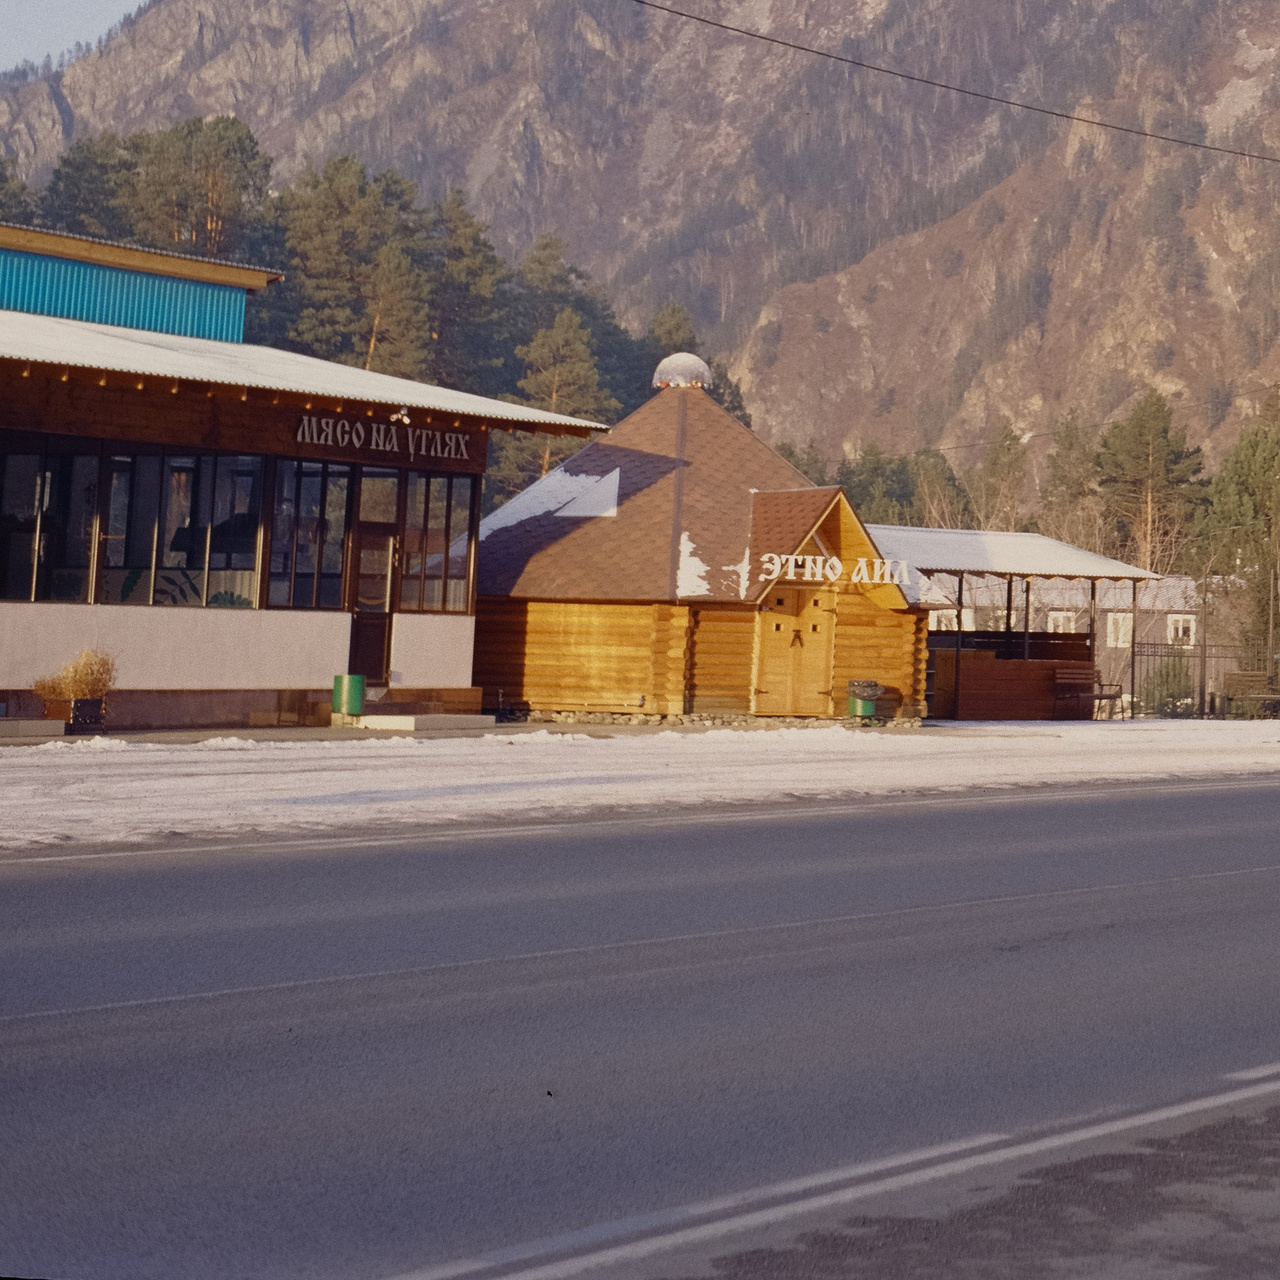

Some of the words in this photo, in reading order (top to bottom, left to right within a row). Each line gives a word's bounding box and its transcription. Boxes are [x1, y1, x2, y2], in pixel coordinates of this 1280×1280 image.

[296, 415, 365, 449] МЯСО
[369, 423, 399, 452] НА
[406, 427, 470, 462] УГЛЯХ
[758, 553, 843, 582] ЭТНО
[851, 557, 911, 585] АИЛ
